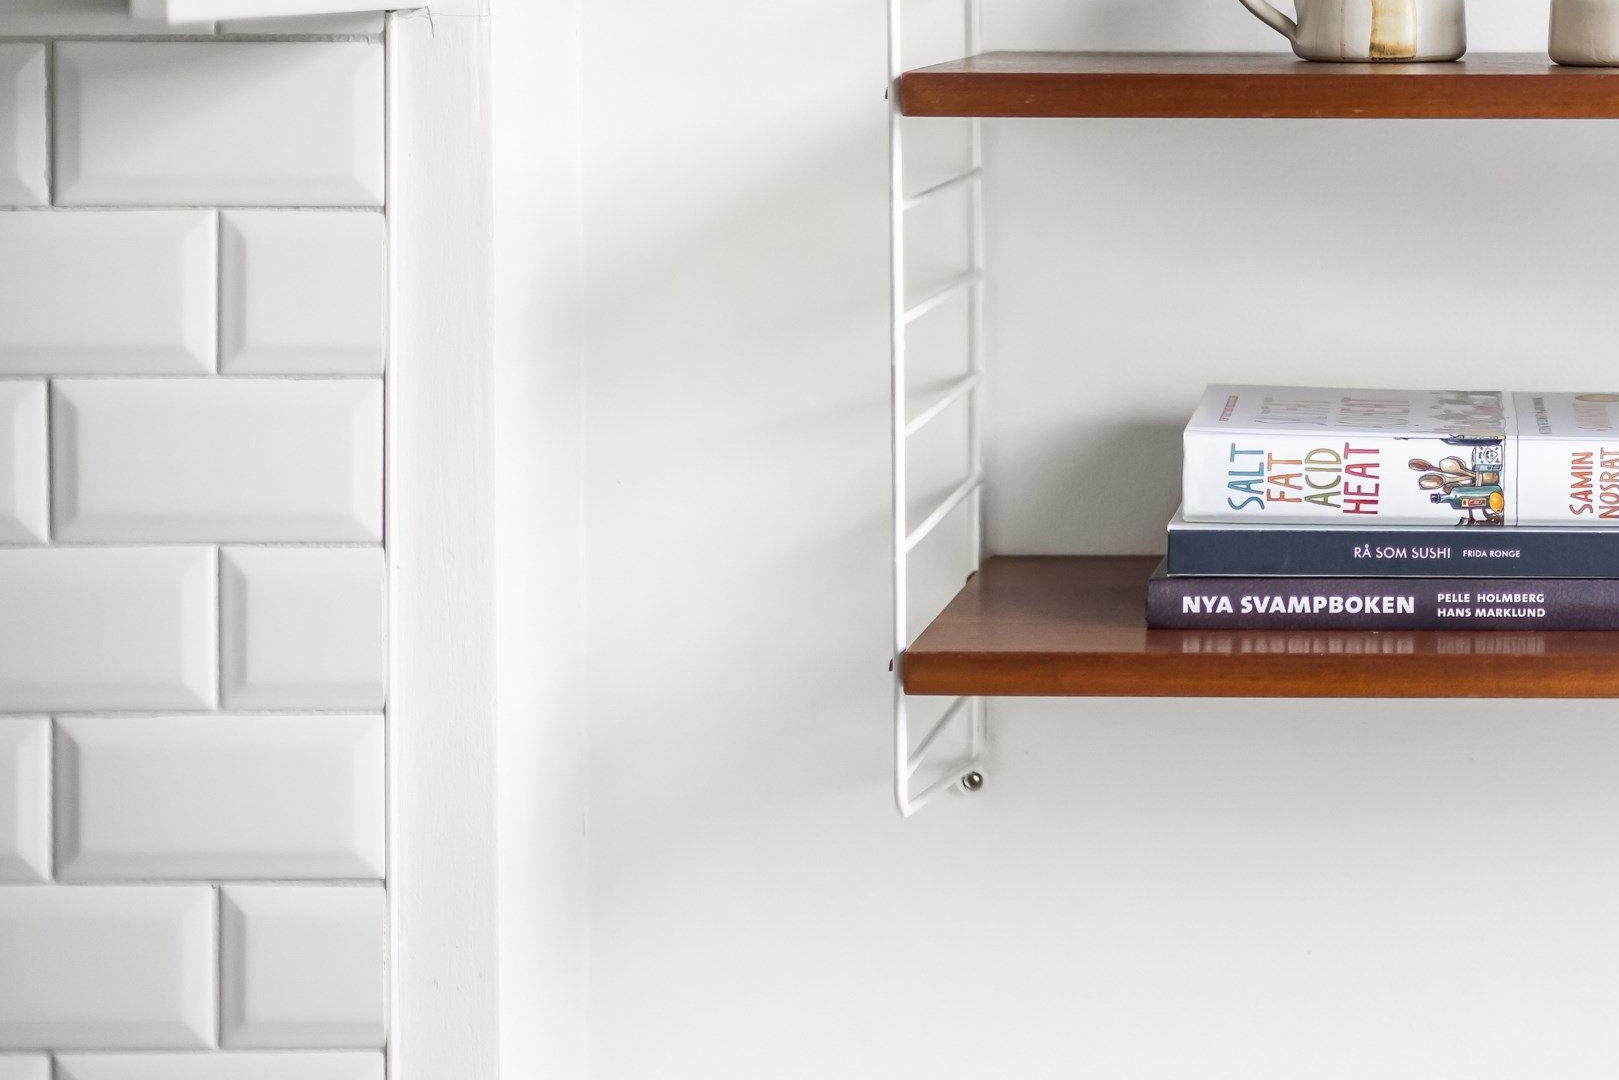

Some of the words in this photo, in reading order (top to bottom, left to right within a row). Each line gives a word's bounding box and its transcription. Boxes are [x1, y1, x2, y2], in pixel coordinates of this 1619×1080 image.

[1227, 442, 1265, 510] SALT
[1266, 452, 1303, 503] FAT
[1304, 448, 1342, 508] ACID
[1342, 442, 1380, 515] HEAT
[1569, 451, 1594, 516] SAMIN
[1354, 543, 1372, 559] RÅ
[1375, 546, 1408, 559] SOM
[1411, 546, 1451, 560] SUSHI
[1462, 549, 1488, 558] FRIDA
[1489, 549, 1521, 558] RONGE
[1182, 595, 1234, 614] NYA
[1240, 595, 1415, 614] SVAMPBOKEN
[1437, 593, 1471, 603] PELLE
[1477, 593, 1545, 603] HOLMBERG
[1437, 607, 1472, 618] HANS
[1474, 607, 1546, 618] MARKLUND
